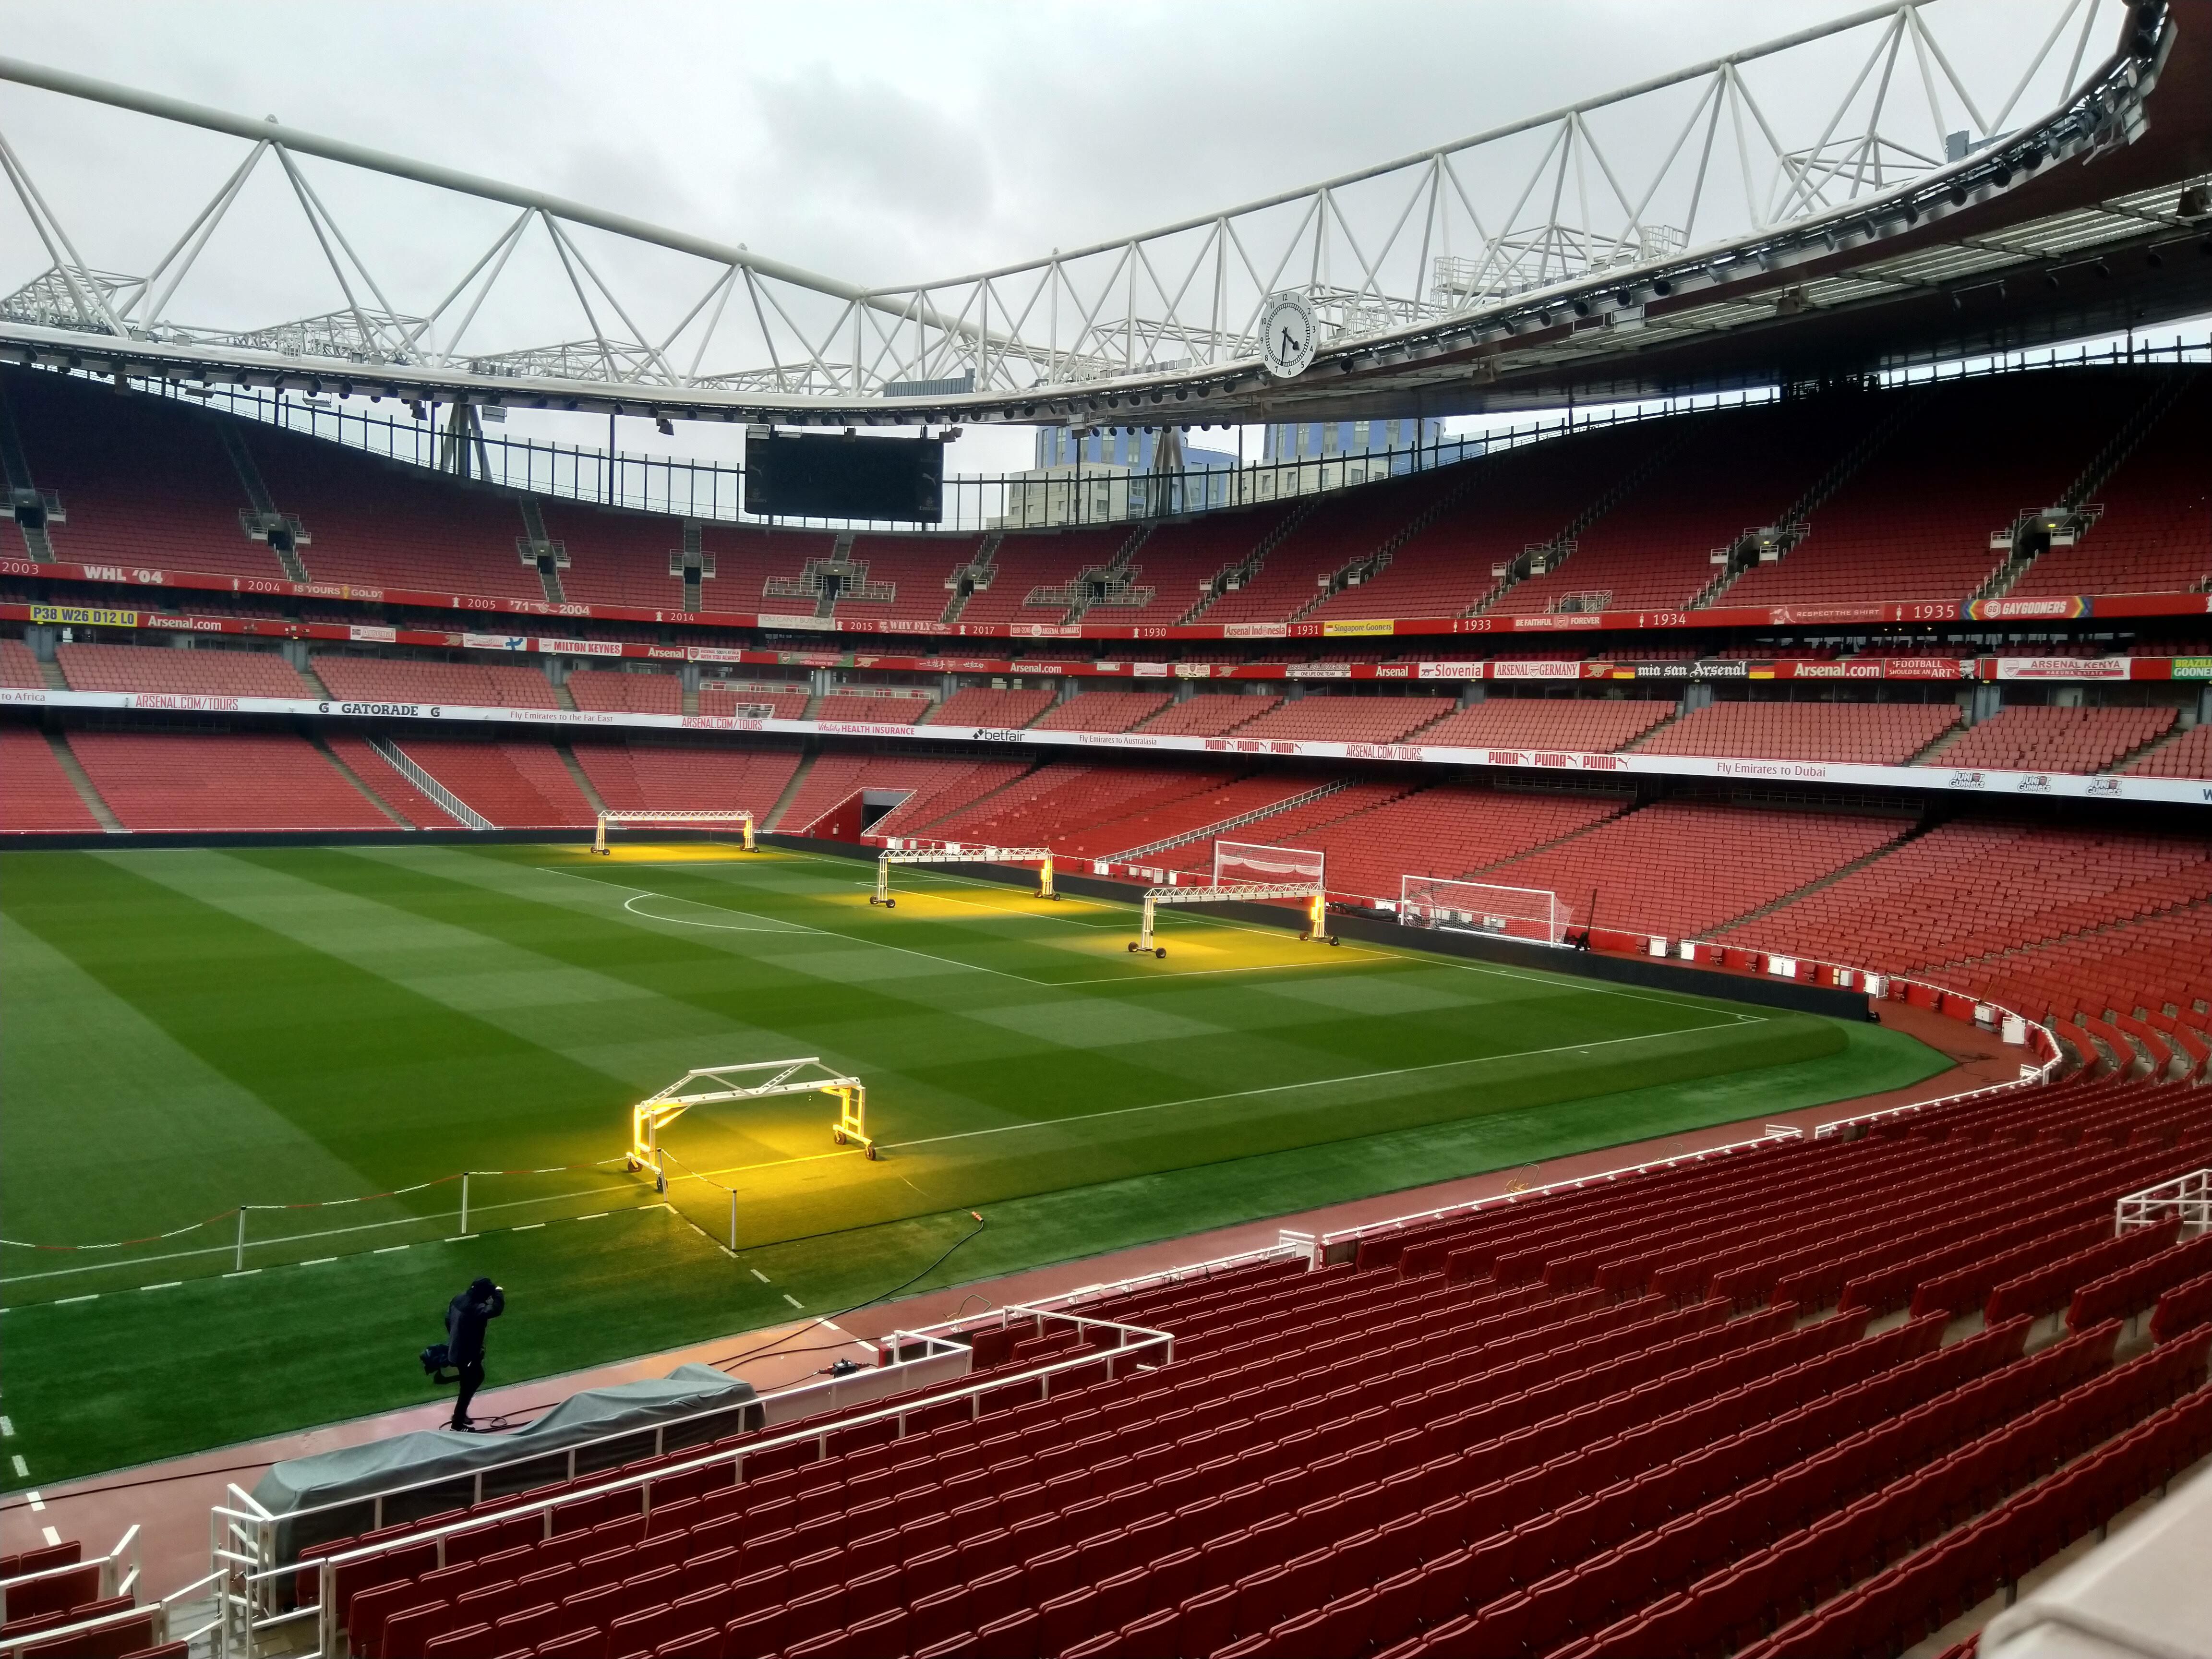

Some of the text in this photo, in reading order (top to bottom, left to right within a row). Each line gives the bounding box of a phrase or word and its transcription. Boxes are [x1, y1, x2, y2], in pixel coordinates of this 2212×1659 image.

[2, 562, 39, 575] 2003
[83, 565, 126, 582] WHL
[248, 580, 280, 592] 2004
[294, 584, 383, 598] IS YOURS GOLD?
[468, 599, 496, 609] 2005
[559, 604, 590, 615] 2004
[2002, 601, 2067, 614] GAYGOONERS
[34, 607, 57, 620] P38
[61, 608, 89, 622] W26
[94, 610, 116, 624] D12
[671, 613, 694, 622] 2014
[1914, 606, 1954, 618] 1935
[148, 615, 222, 631] Arsenal.com
[1465, 620, 1491, 630] 1933
[1524, 618, 1552, 626] FAITHFUL
[1571, 616, 1599, 625] FOREVER
[1653, 613, 1686, 625] 1934
[851, 622, 872, 630] 2015
[890, 621, 932, 630] WHY FLY
[973, 626, 995, 635] 2017
[1226, 626, 1250, 636] Arsenal
[1297, 625, 1319, 635] 1931
[1334, 624, 1364, 633] Singapore
[1144, 628, 1166, 637] 1930
[554, 641, 620, 654] MILTON KEYNES
[648, 648, 684, 658] Arsenal
[1010, 662, 1062, 674] Arsenal.com
[1435, 664, 1481, 677] Slovenia
[1497, 664, 1577, 676] ARSENAL GERMANY
[1638, 661, 1747, 677] mia san Arsenal
[1794, 663, 1879, 677] Arsenal.com
[2031, 660, 2120, 669] ARSENAL KENYA
[1376, 666, 1408, 677] Arsenal
[2175, 667, 2212, 676] GOONE
[15, 693, 46, 701] Africa
[135, 694, 238, 710] ARSENAL.COM/TOURS
[319, 703, 329, 713] G
[341, 703, 419, 716] GATORADE
[431, 708, 440, 717] G
[511, 711, 522, 720] Fly
[525, 711, 557, 720] Emirates
[570, 712, 582, 721] the
[584, 713, 595, 721] Far
[598, 714, 613, 722] East
[682, 717, 762, 730] ARSENAL.COM/TOURS
[817, 723, 914, 735] Vitality HEALTH INSURANCE
[985, 729, 1025, 742] betfair
[1080, 734, 1088, 744] Fly
[1090, 735, 1114, 744] Emirates
[1124, 737, 1157, 745] Australasia
[1205, 739, 1226, 750] PUMA
[1237, 741, 1259, 752] PUMA
[1271, 743, 1294, 754] PUMA
[1346, 745, 1421, 760] ARSENAL.COM/TOURS
[1489, 752, 1518, 765] PUMA
[1535, 754, 1566, 767] PUMA
[1583, 755, 1616, 769] PUMA
[1717, 762, 1826, 777] Fly Emirates to Dubai
